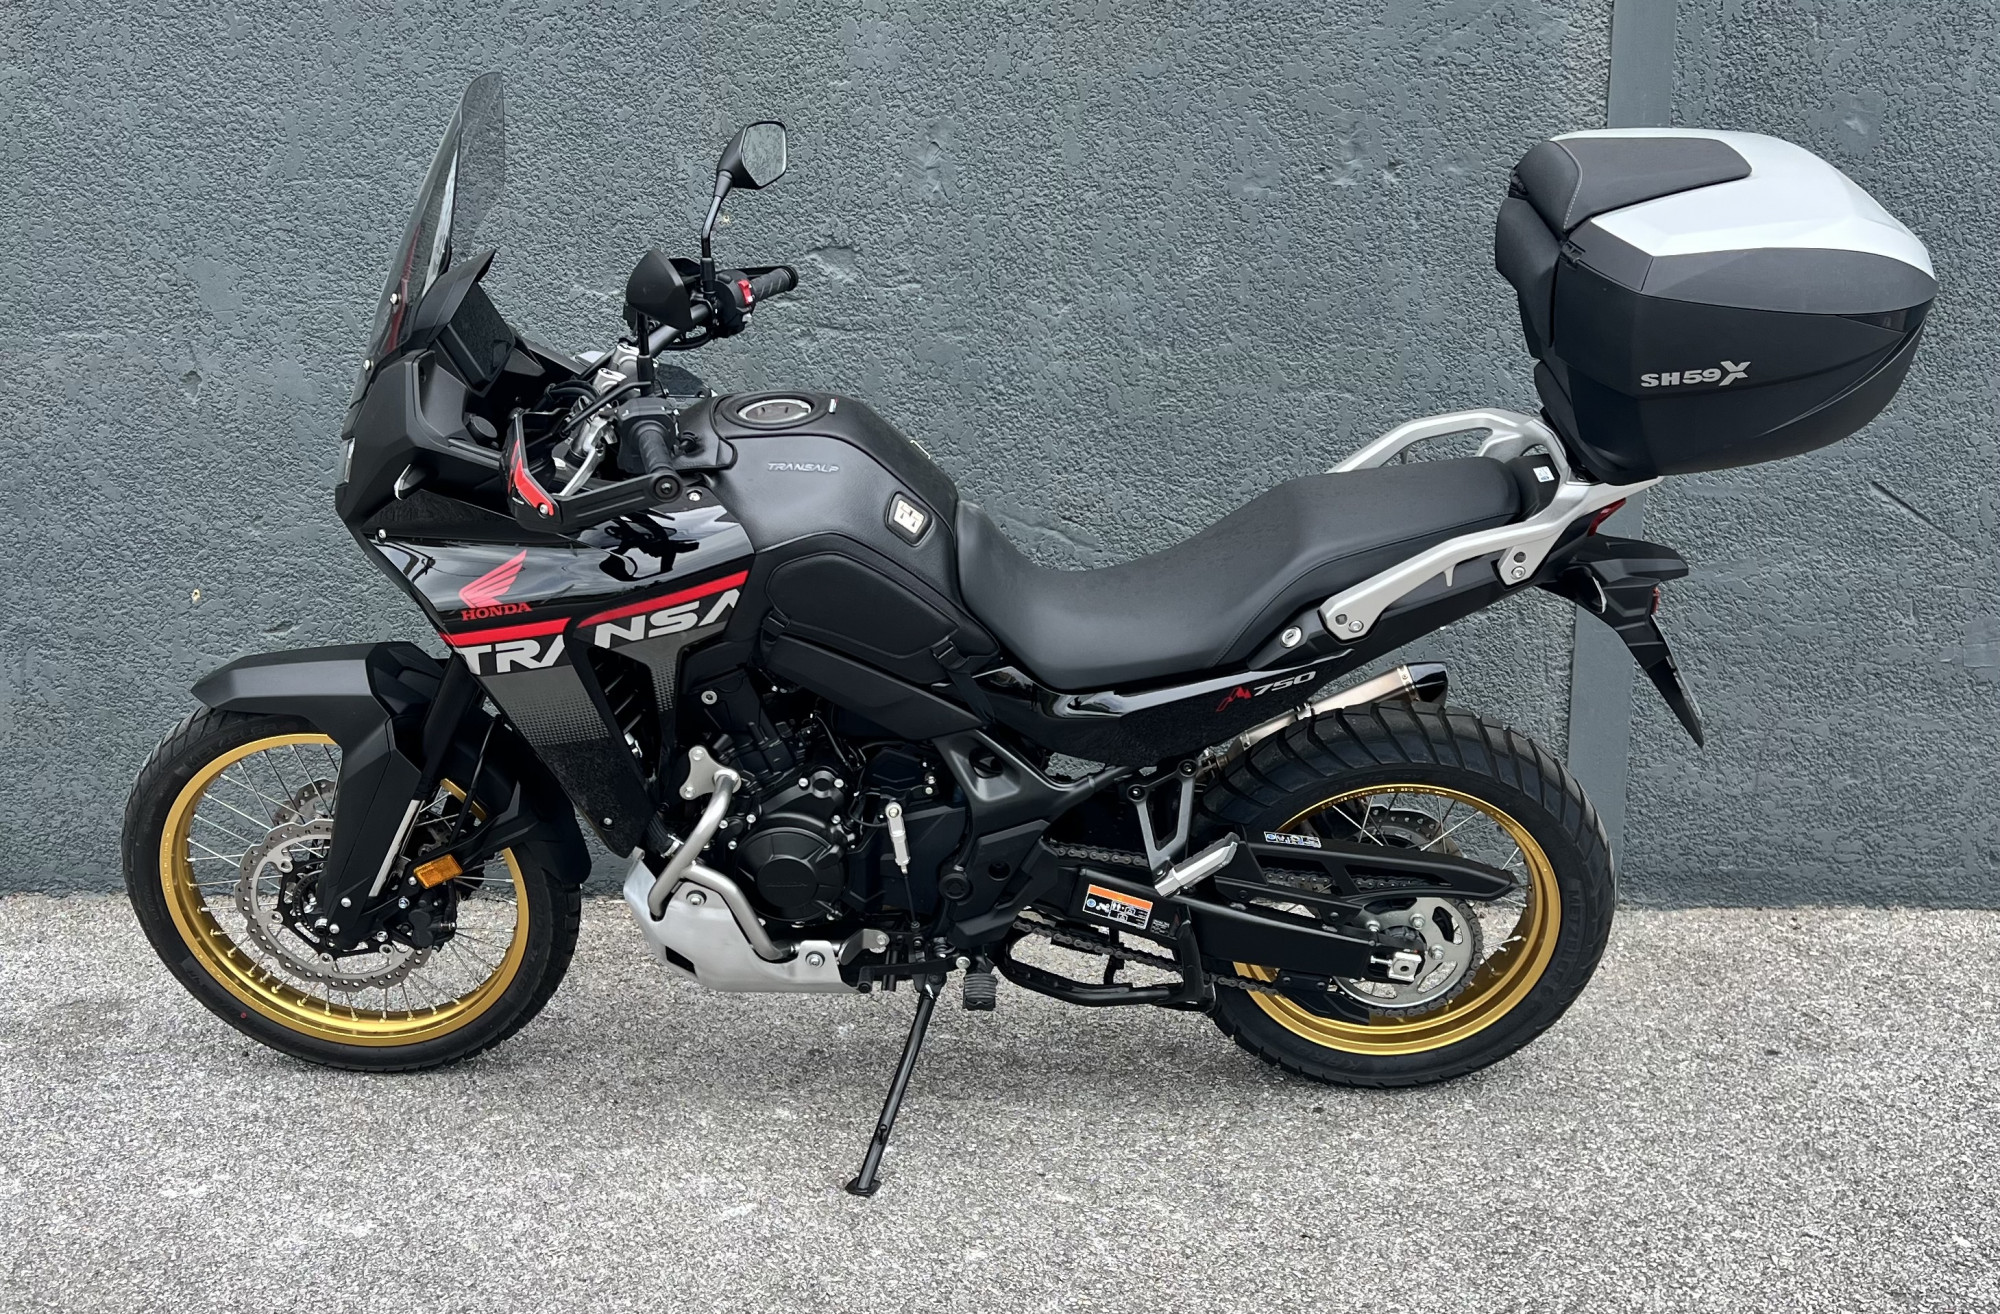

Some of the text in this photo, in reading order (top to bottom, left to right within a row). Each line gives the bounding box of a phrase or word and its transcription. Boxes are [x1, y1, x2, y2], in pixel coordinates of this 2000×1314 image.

[767, 462, 840, 473] TRANSALP
[461, 602, 532, 621] HONDA
[1253, 671, 1317, 696] 750
